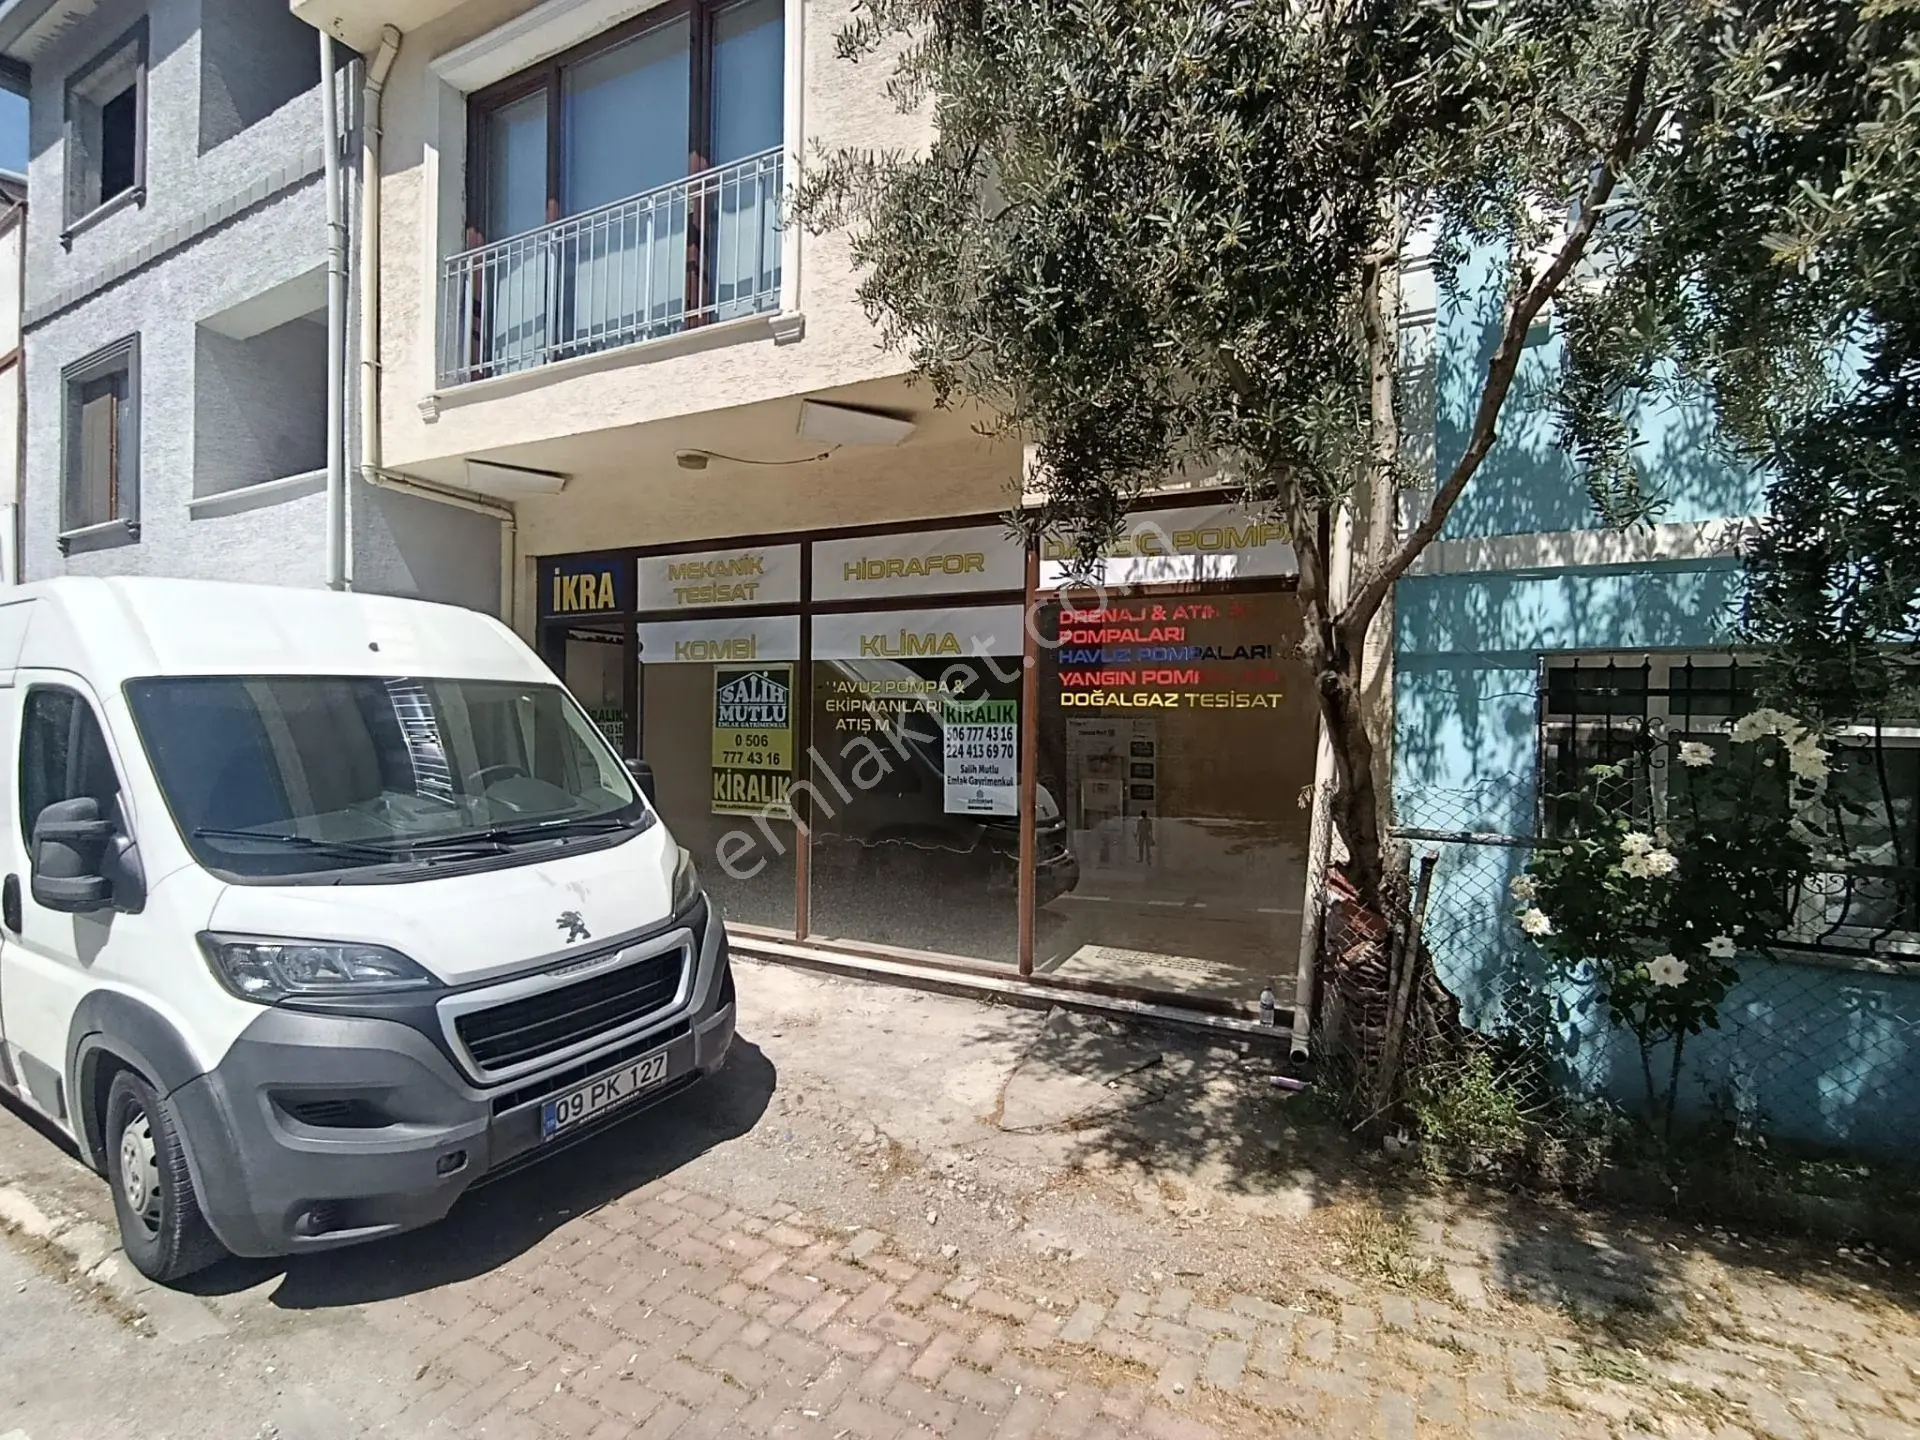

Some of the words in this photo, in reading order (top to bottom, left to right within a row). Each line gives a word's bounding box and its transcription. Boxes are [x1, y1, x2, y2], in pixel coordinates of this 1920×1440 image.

[668, 554, 764, 581] MEKANİK
[843, 553, 985, 581] HİDRAFOR
[552, 568, 616, 612] İKRA
[673, 582, 760, 605] TESİSAT
[1059, 607, 1146, 625] DRENAJ
[1151, 604, 1167, 621] &
[860, 629, 961, 657] KLİMA
[1059, 626, 1185, 645] POMPALARI
[675, 634, 756, 661] KOMBİ
[1138, 644, 1273, 662] POMPALARI
[722, 671, 784, 703] SALİH
[885, 679, 949, 694] POMPA
[953, 680, 965, 694] &
[1058, 670, 1136, 687] YANGIN
[826, 696, 942, 714] EKİPMANLARI
[1060, 689, 1179, 708] DOĞALGAZ
[1184, 690, 1283, 709] TESİSAT
[719, 705, 787, 722] MUTLU
[835, 717, 871, 736] ATIŞ
[946, 726, 965, 742] 506
[967, 726, 984, 741] 777
[986, 726, 999, 742] 43
[1001, 726, 1013, 741] 16
[735, 734, 742, 747] 0
[745, 734, 769, 747] 506
[723, 750, 743, 764] 777
[747, 751, 763, 765] 43
[766, 752, 780, 765] 16
[946, 744, 964, 759] 224
[966, 744, 984, 759] 413
[986, 744, 999, 759] 69
[1001, 744, 1014, 759] 70
[713, 768, 791, 803] KİRALIK
[556, 1092, 584, 1124] 09
[590, 1075, 622, 1108] PK
[631, 1056, 665, 1088] 127
